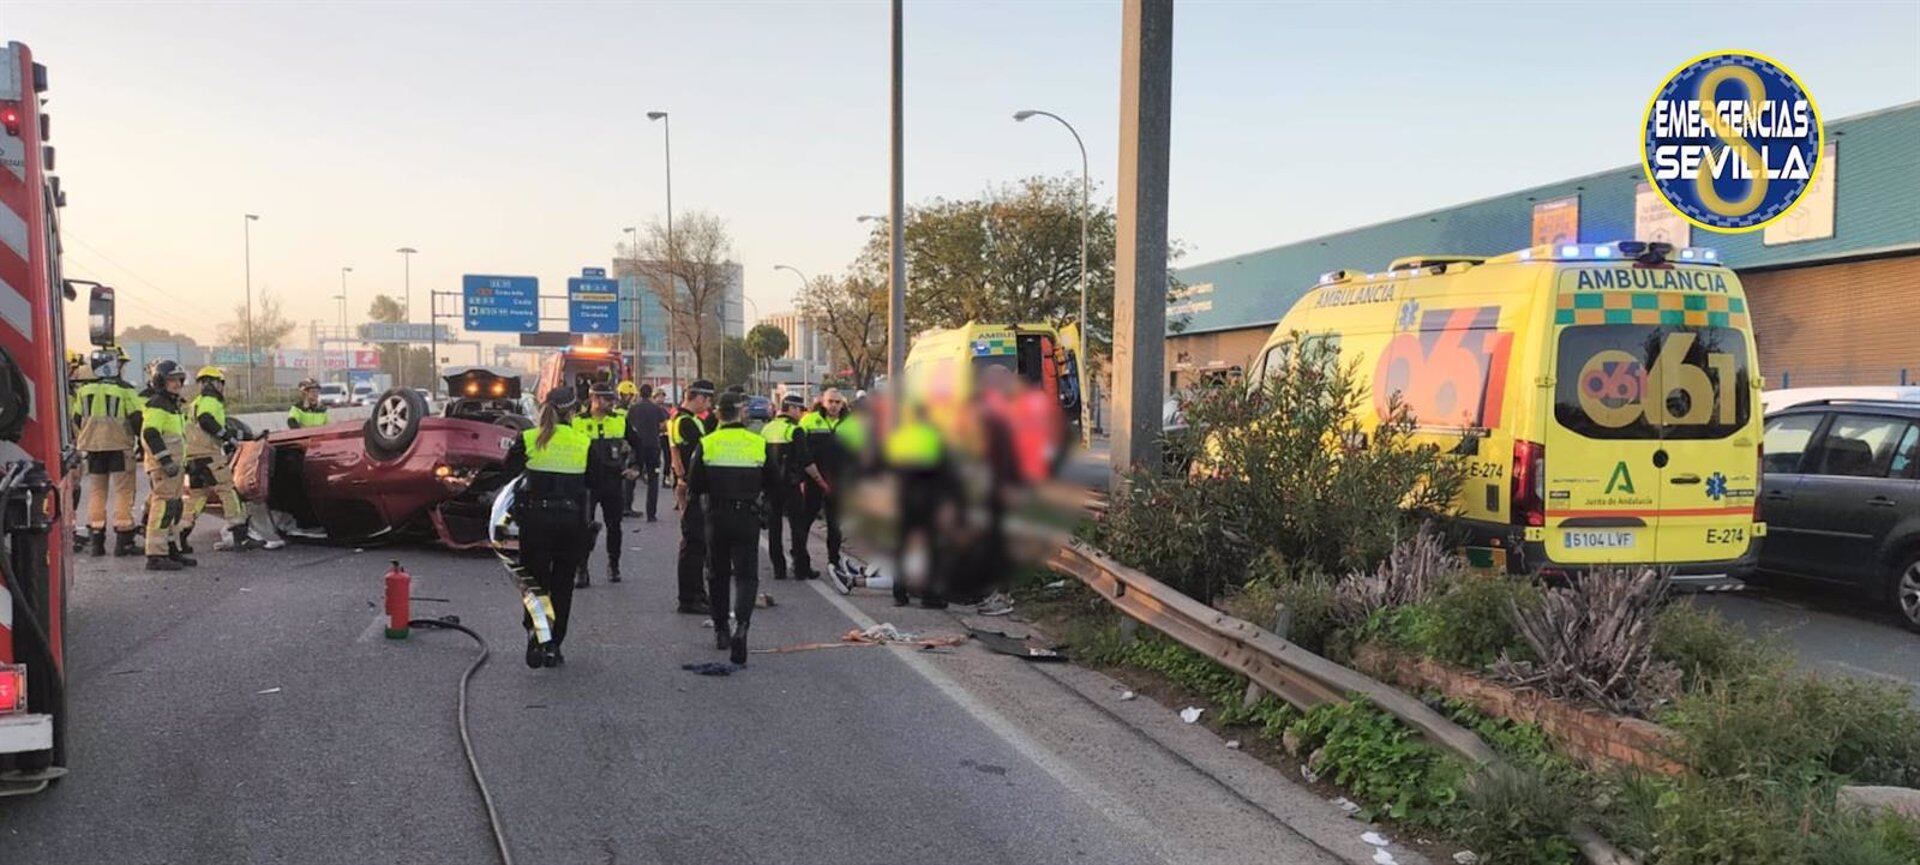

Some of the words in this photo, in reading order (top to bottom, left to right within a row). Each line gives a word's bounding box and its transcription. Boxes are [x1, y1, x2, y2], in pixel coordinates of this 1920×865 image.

[1577, 269, 1728, 293] AMBULANCIA
[1315, 284, 1395, 309] AMBULANCIA
[1373, 306, 1515, 429] 061
[1577, 332, 1737, 429] 061
[1471, 462, 1503, 479] E-274
[1573, 533, 1604, 546] 5104
[1608, 532, 1632, 546] LVF
[1707, 528, 1743, 543] E-274
